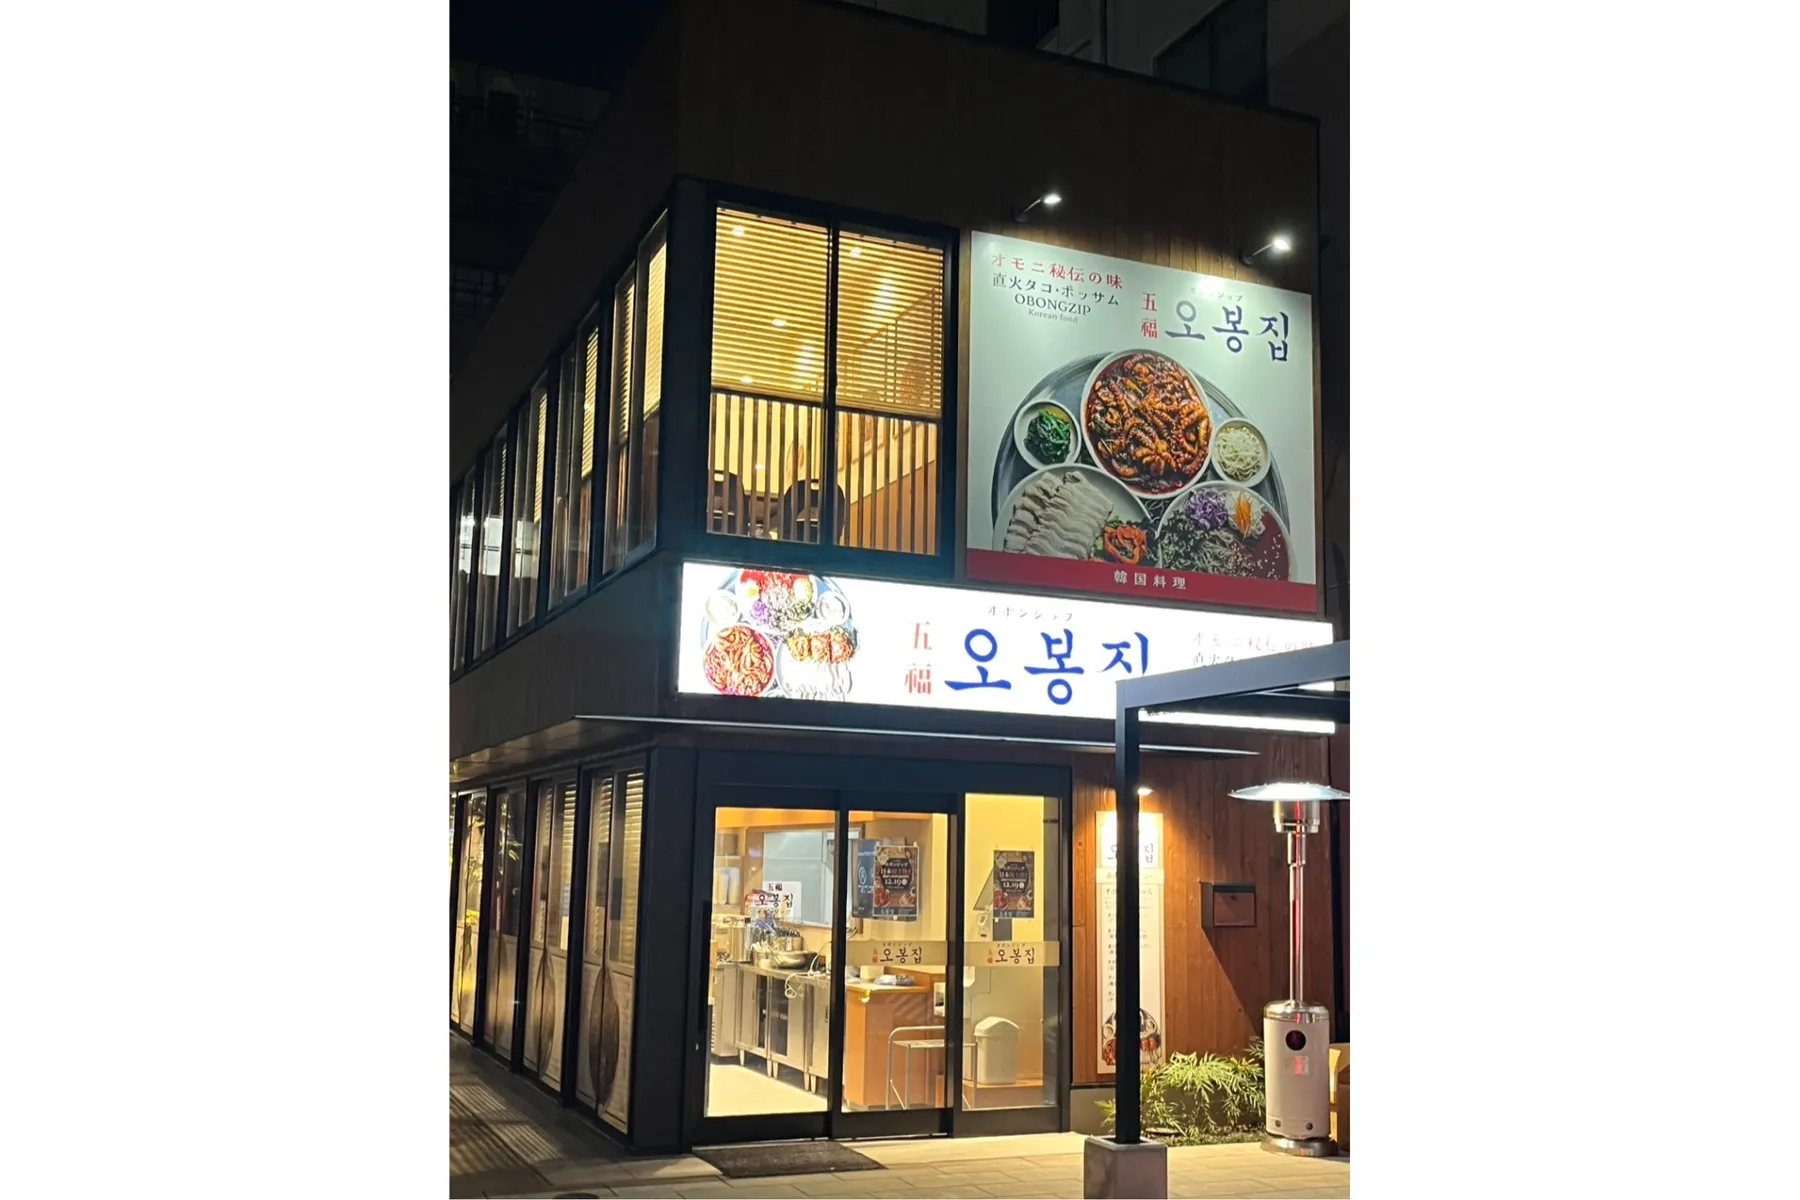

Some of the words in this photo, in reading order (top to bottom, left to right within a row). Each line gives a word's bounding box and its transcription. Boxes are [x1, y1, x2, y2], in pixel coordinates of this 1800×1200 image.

[991, 253, 1123, 290] オモニ秘伝の味
[1014, 293, 1092, 316] OBONGZIP
[1028, 308, 1058, 320] Korean
[1060, 314, 1078, 323] food
[1141, 292, 1158, 339] 五福
[1165, 300, 1289, 361] 오봉집
[1114, 569, 1186, 590] 韓国料理
[905, 621, 932, 695] 五福
[880, 946, 922, 964] 오봉집
[995, 947, 1035, 965] 오봉집
